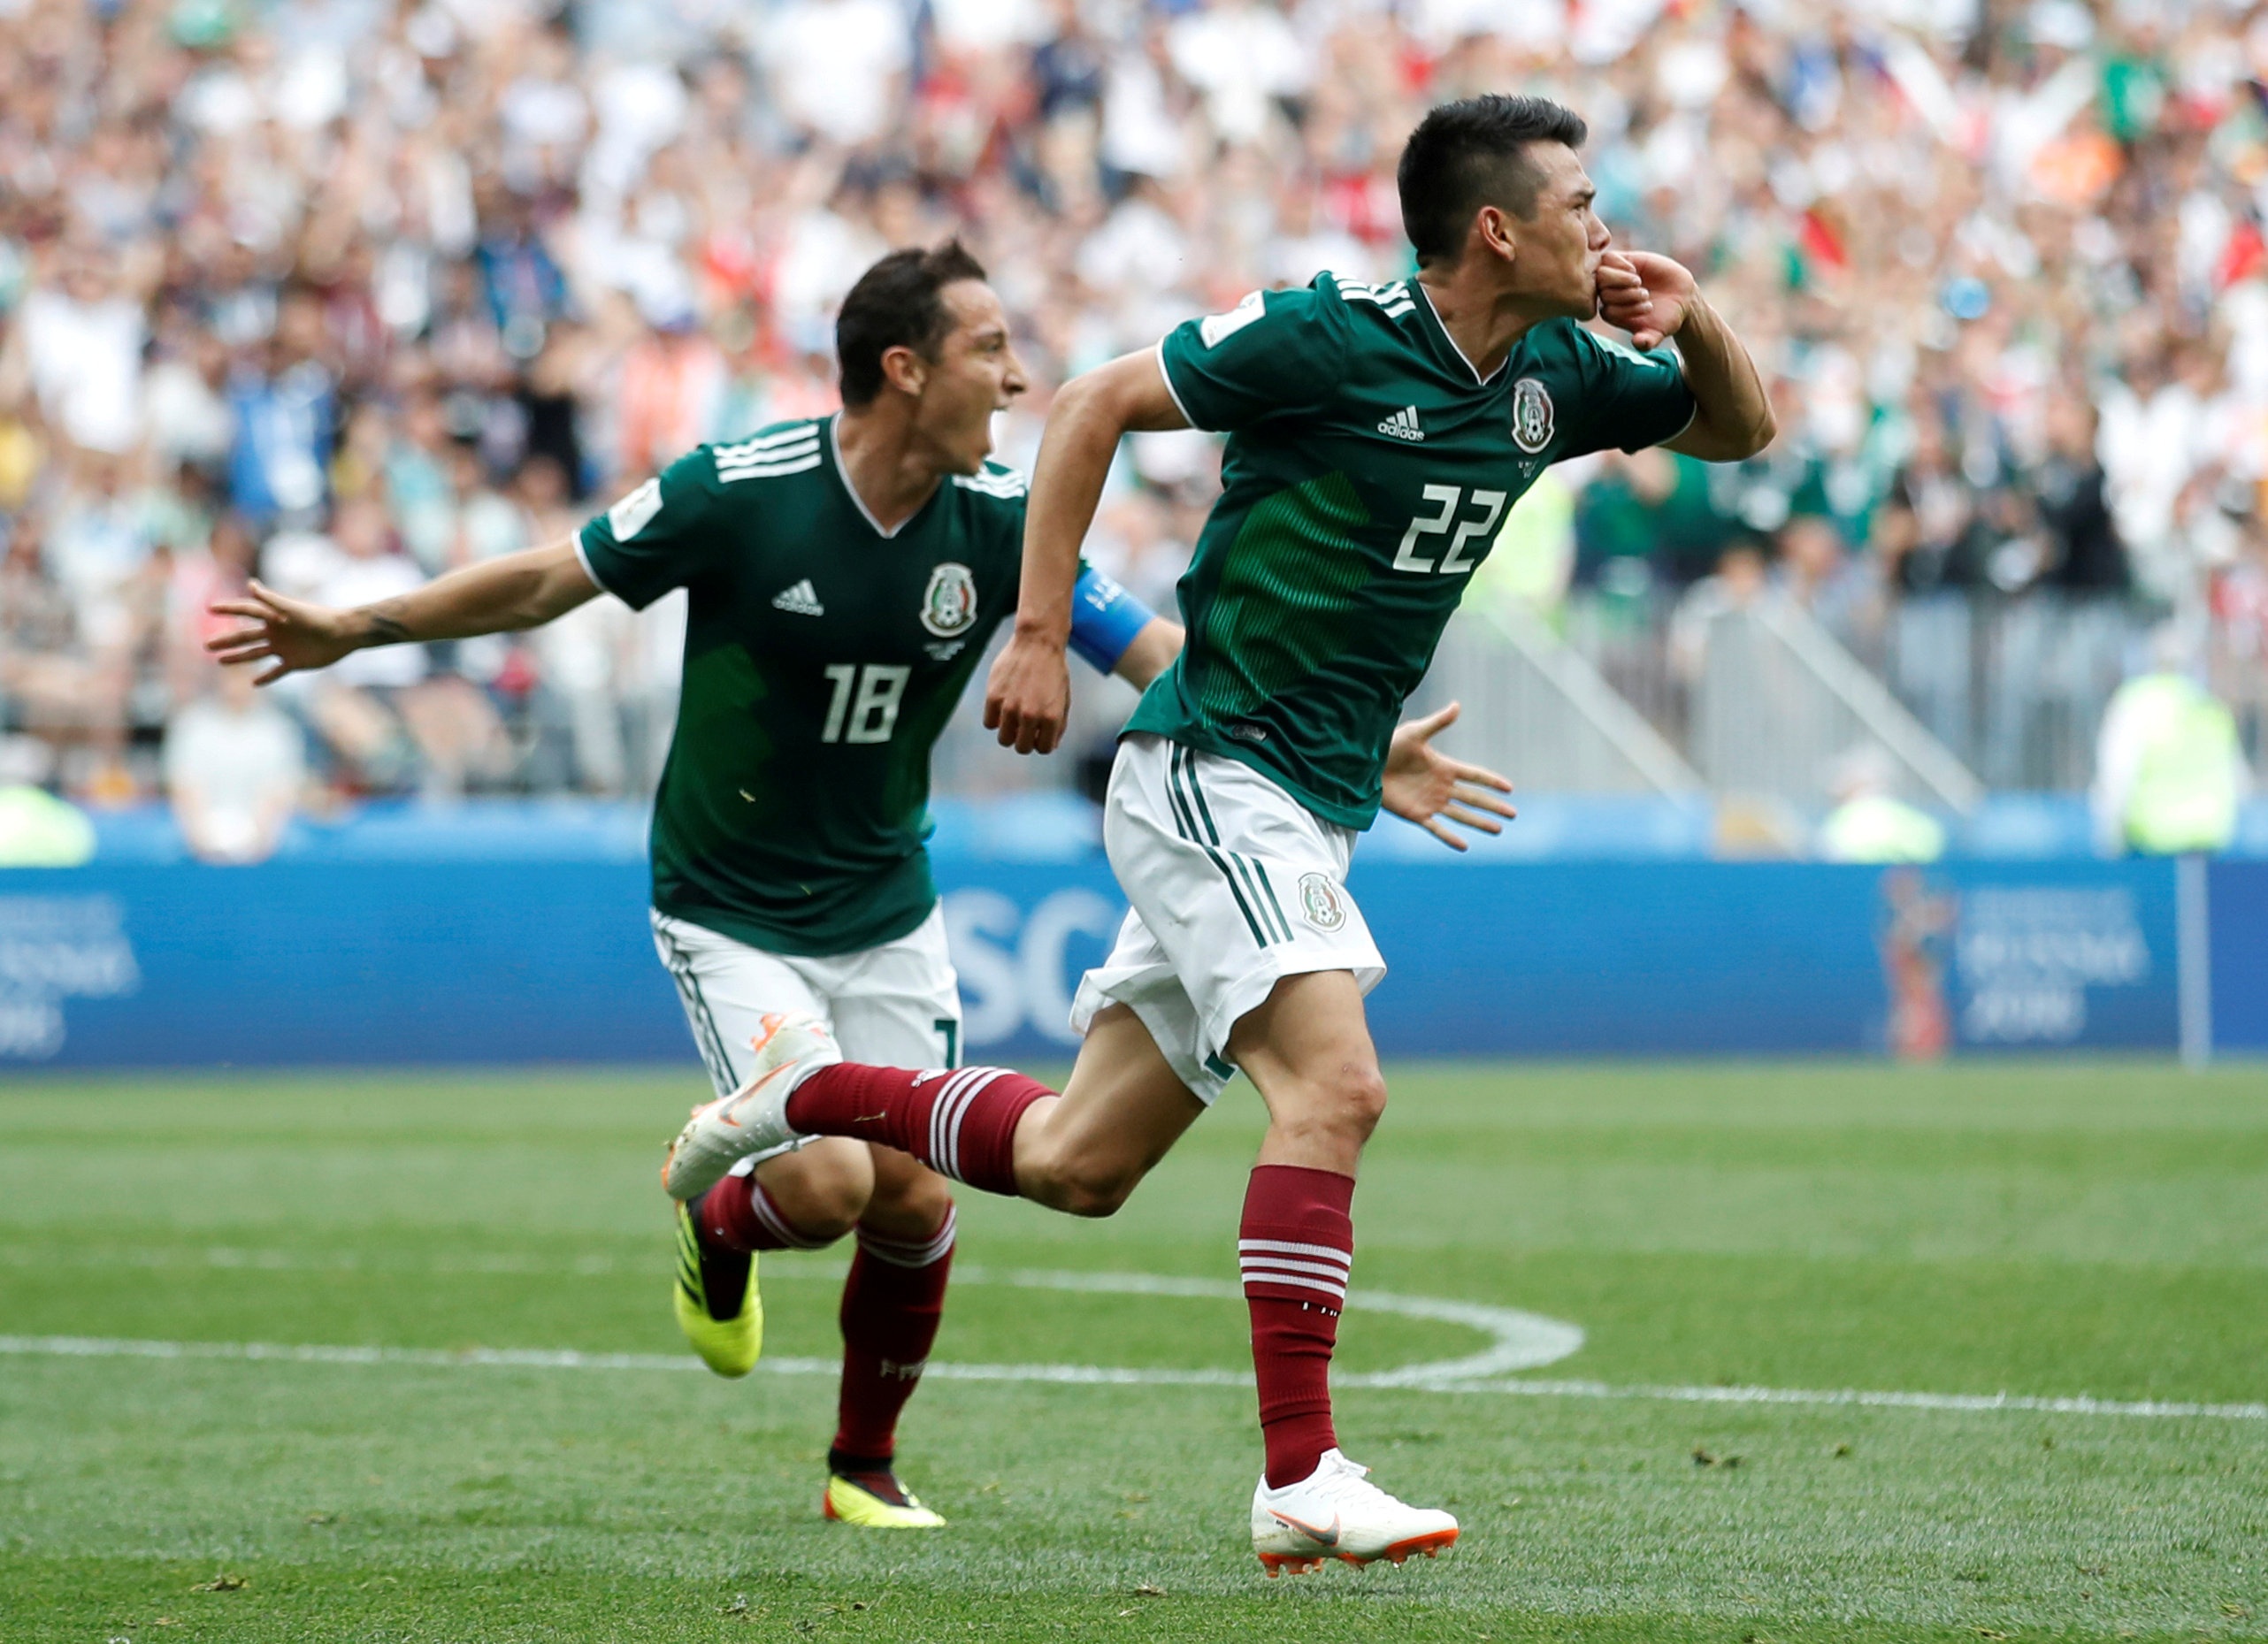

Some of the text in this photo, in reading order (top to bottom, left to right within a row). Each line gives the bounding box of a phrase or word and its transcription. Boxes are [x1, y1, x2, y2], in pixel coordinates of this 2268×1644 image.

[1377, 422, 1425, 441] adidas
[1393, 484, 1507, 574] 22
[822, 663, 912, 744] 18
